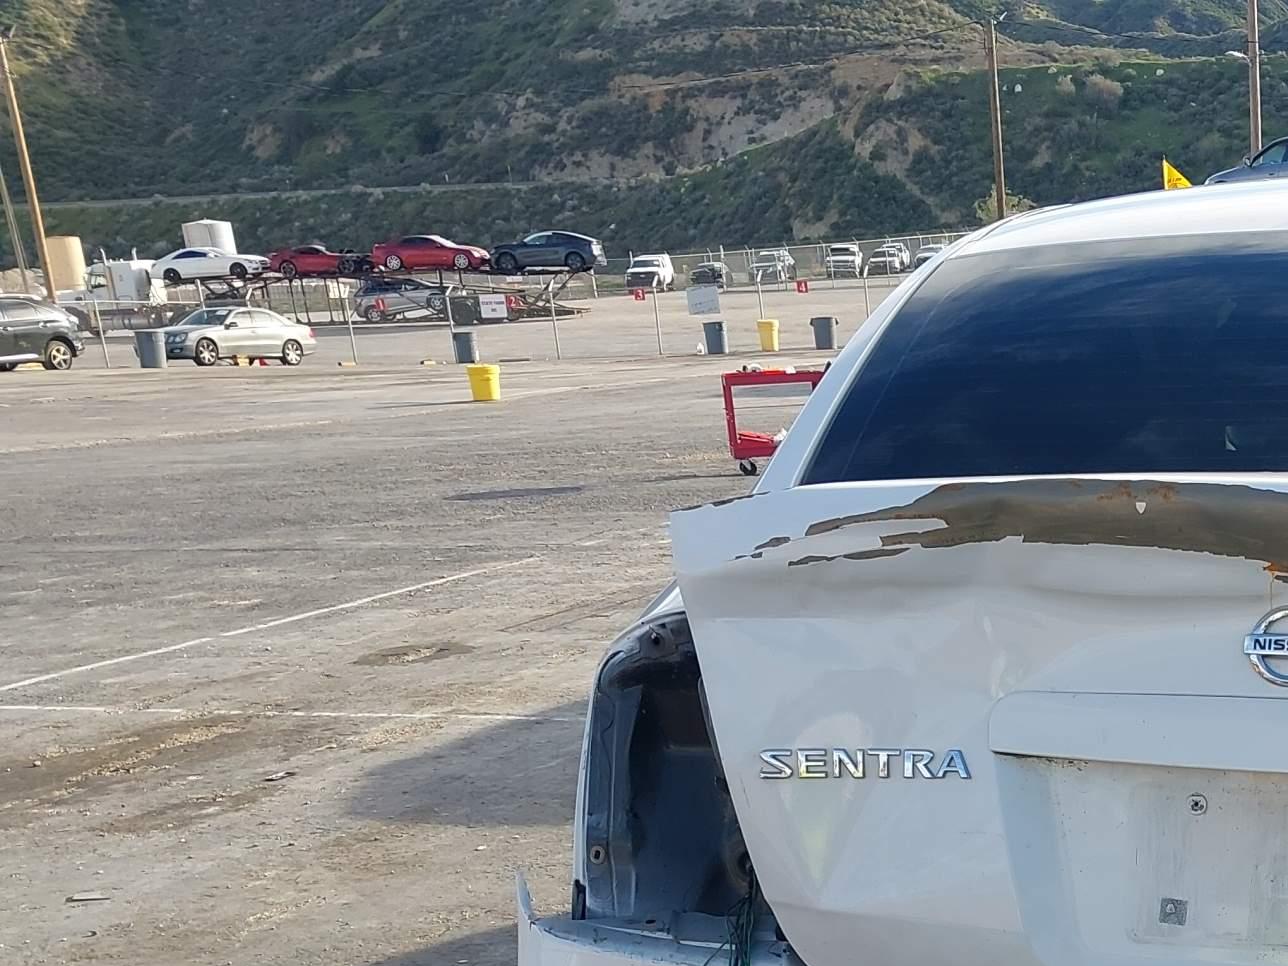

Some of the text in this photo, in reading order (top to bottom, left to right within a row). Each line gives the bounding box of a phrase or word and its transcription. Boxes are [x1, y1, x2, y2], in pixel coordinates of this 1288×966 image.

[799, 281, 806, 292] 4
[636, 289, 643, 300] 3
[509, 296, 516, 307] 2
[759, 748, 972, 779] SENTRA
